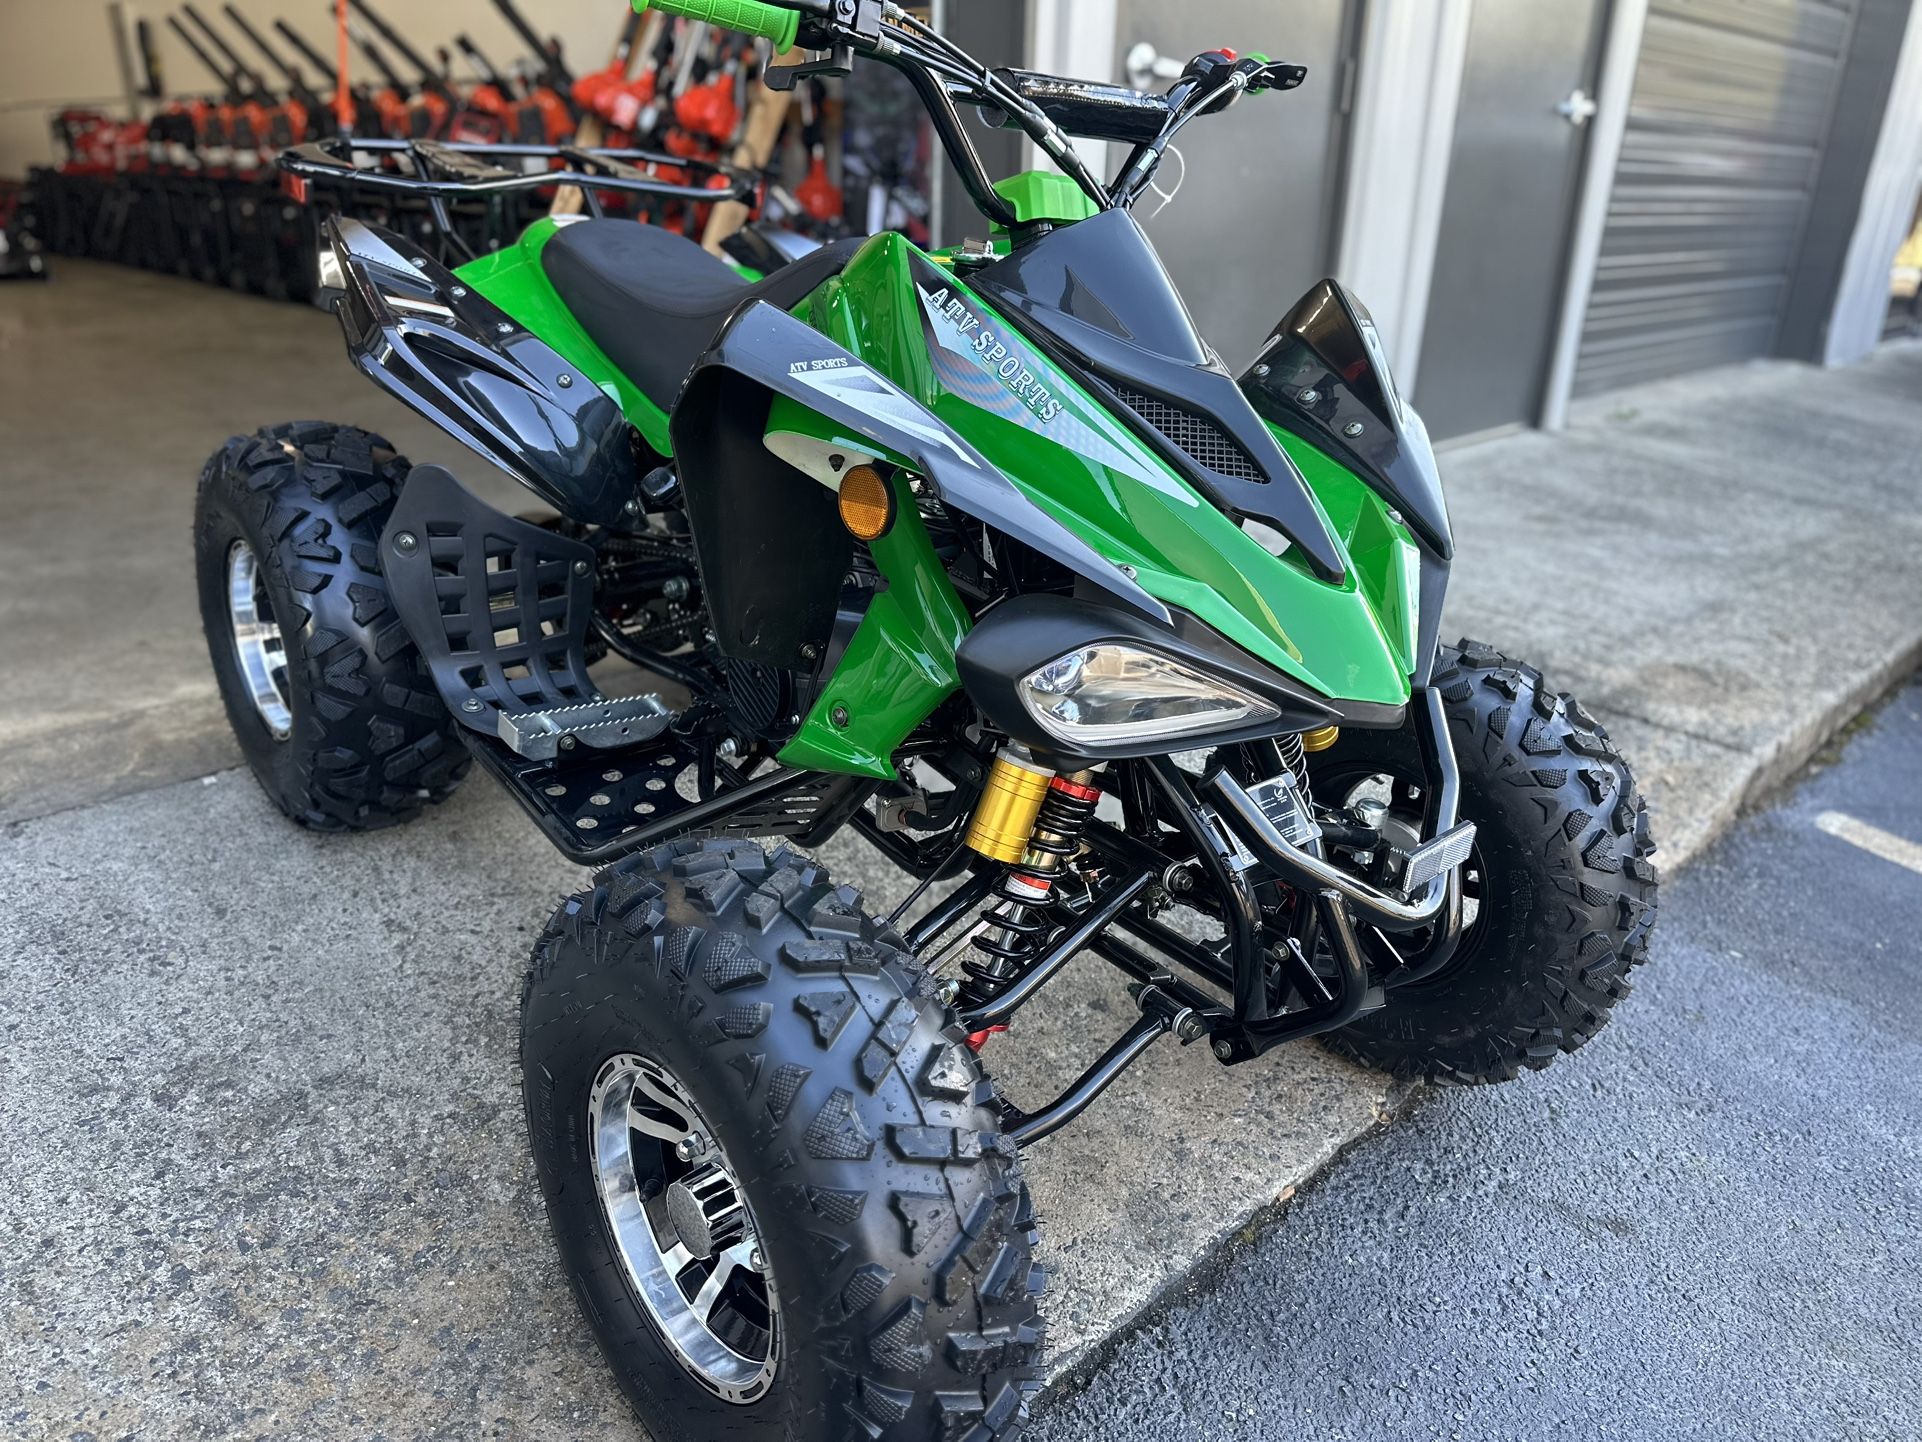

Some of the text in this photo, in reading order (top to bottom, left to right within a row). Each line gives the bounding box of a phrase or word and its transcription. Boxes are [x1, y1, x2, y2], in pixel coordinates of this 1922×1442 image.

[790, 357, 848, 373] ATV SPORTS
[926, 288, 1064, 424] ATV SPORTS
